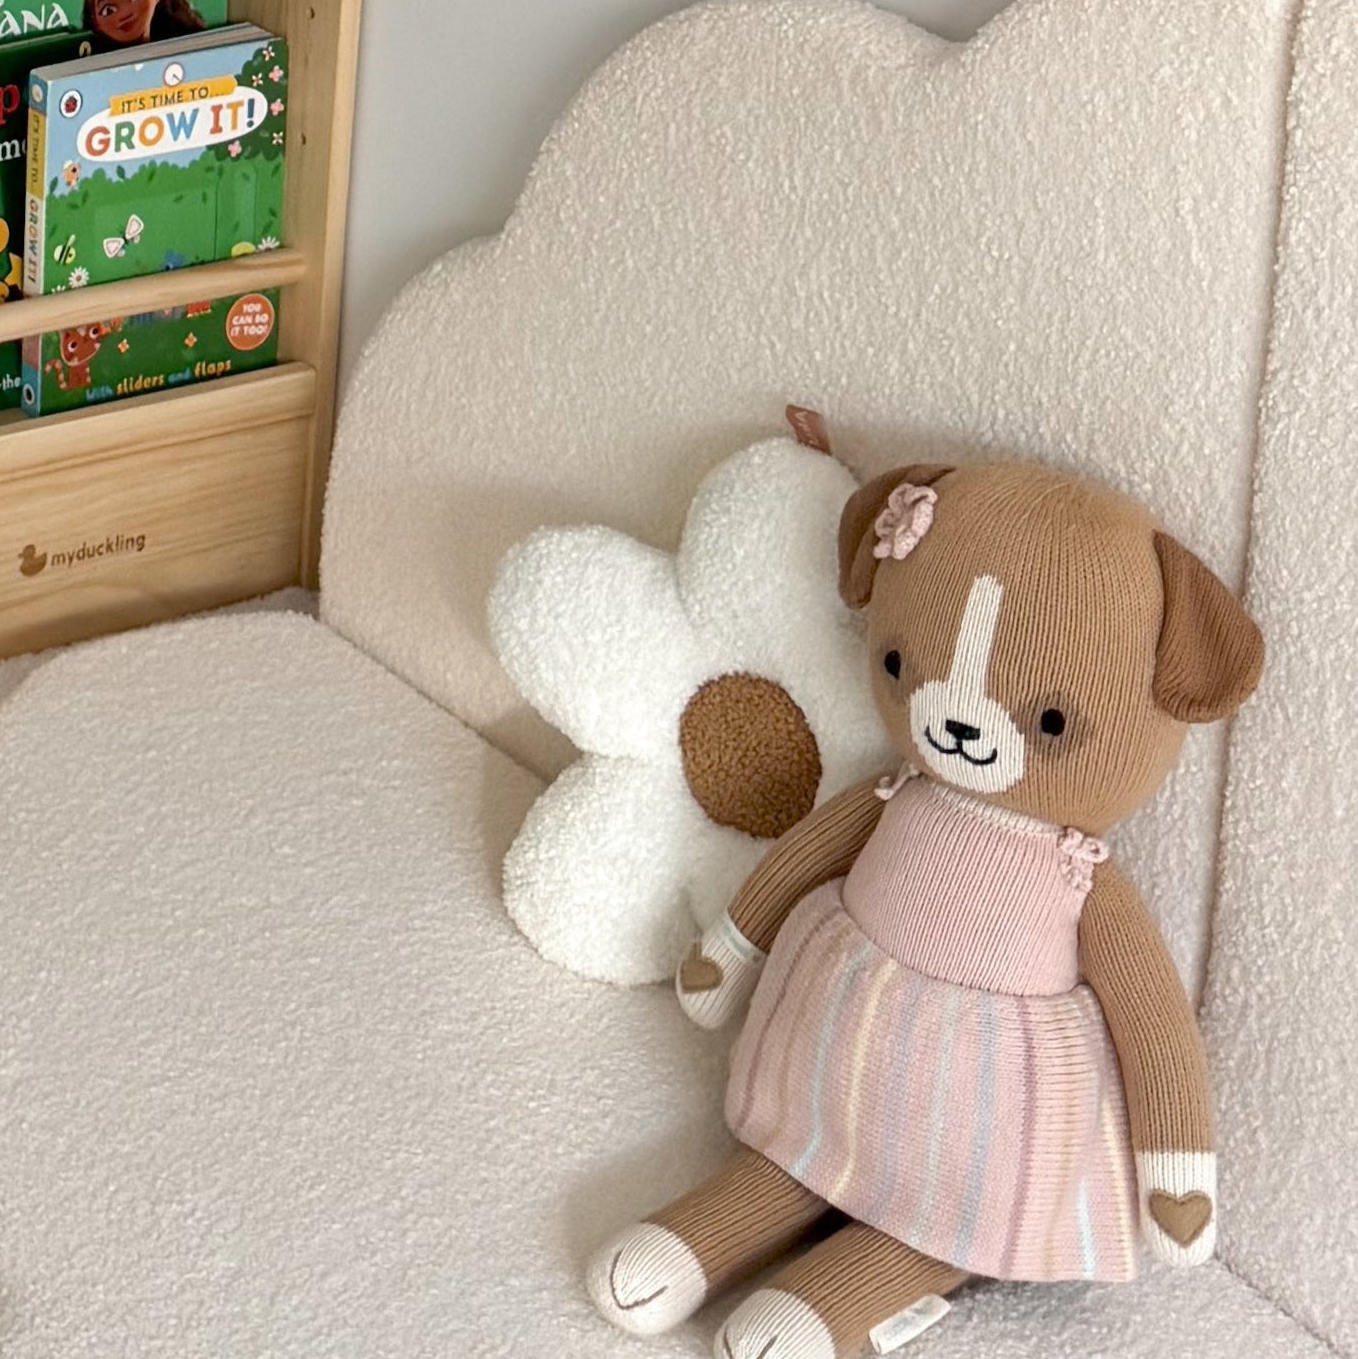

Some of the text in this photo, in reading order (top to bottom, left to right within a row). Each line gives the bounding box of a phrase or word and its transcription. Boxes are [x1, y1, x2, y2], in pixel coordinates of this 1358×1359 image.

[122, 86, 225, 111] IT'S TIME TO...
[51, 535, 147, 567] myduckling
